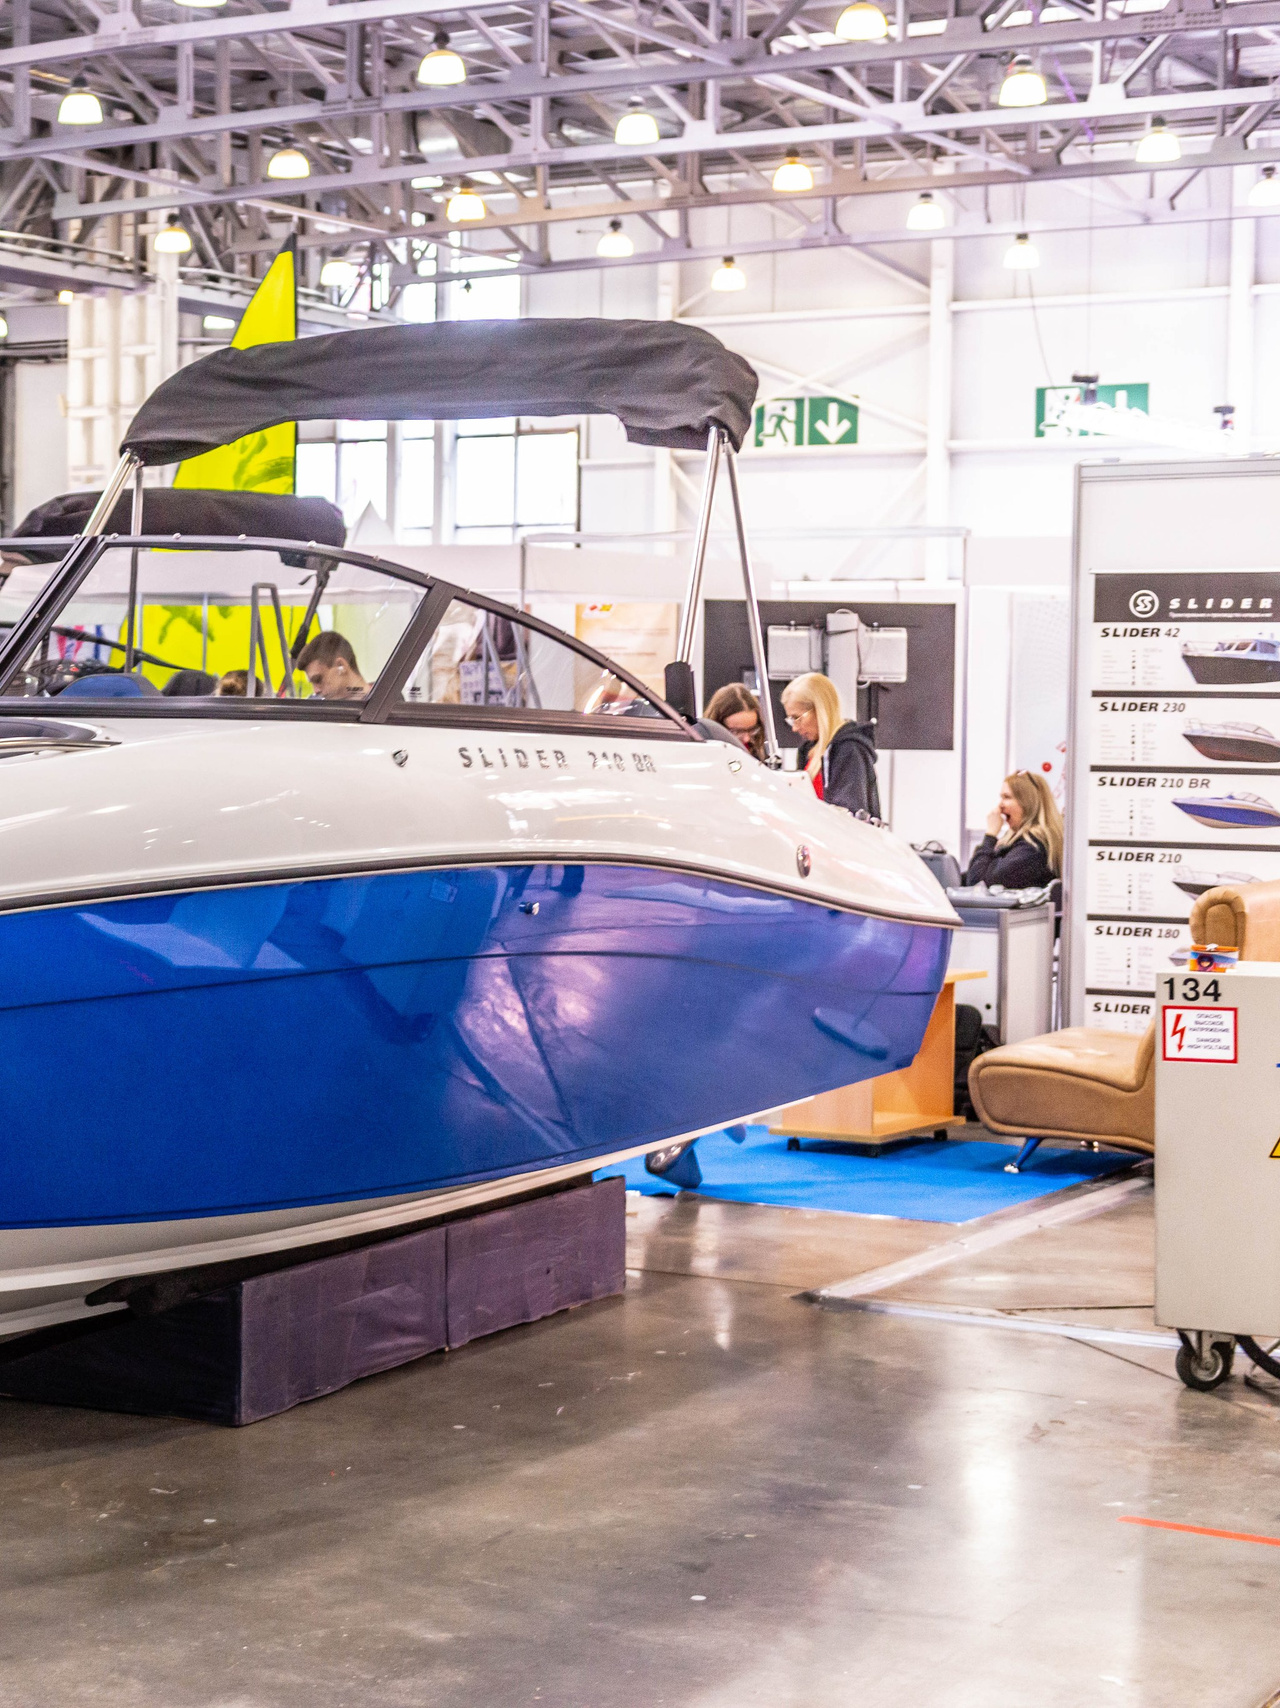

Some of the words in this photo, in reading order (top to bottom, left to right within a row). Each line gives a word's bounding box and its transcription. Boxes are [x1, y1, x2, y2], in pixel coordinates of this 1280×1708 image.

[1169, 598, 1273, 610] SLIDER
[1100, 627, 1161, 638] SLIDER
[1164, 627, 1181, 638] 42
[1099, 701, 1159, 712] SLIDER
[1162, 702, 1186, 713] 230
[458, 746, 570, 769] SLIDER
[1097, 776, 1157, 788] SLIDER
[1160, 777, 1184, 788] 210
[1188, 778, 1211, 789] BR
[1095, 850, 1155, 862] SLIDER
[1158, 852, 1182, 863] 210
[1094, 925, 1153, 938] SLIDER
[1157, 927, 1180, 939] 180
[1163, 977, 1222, 1002] 134
[1092, 1002, 1151, 1015] SLIDER
